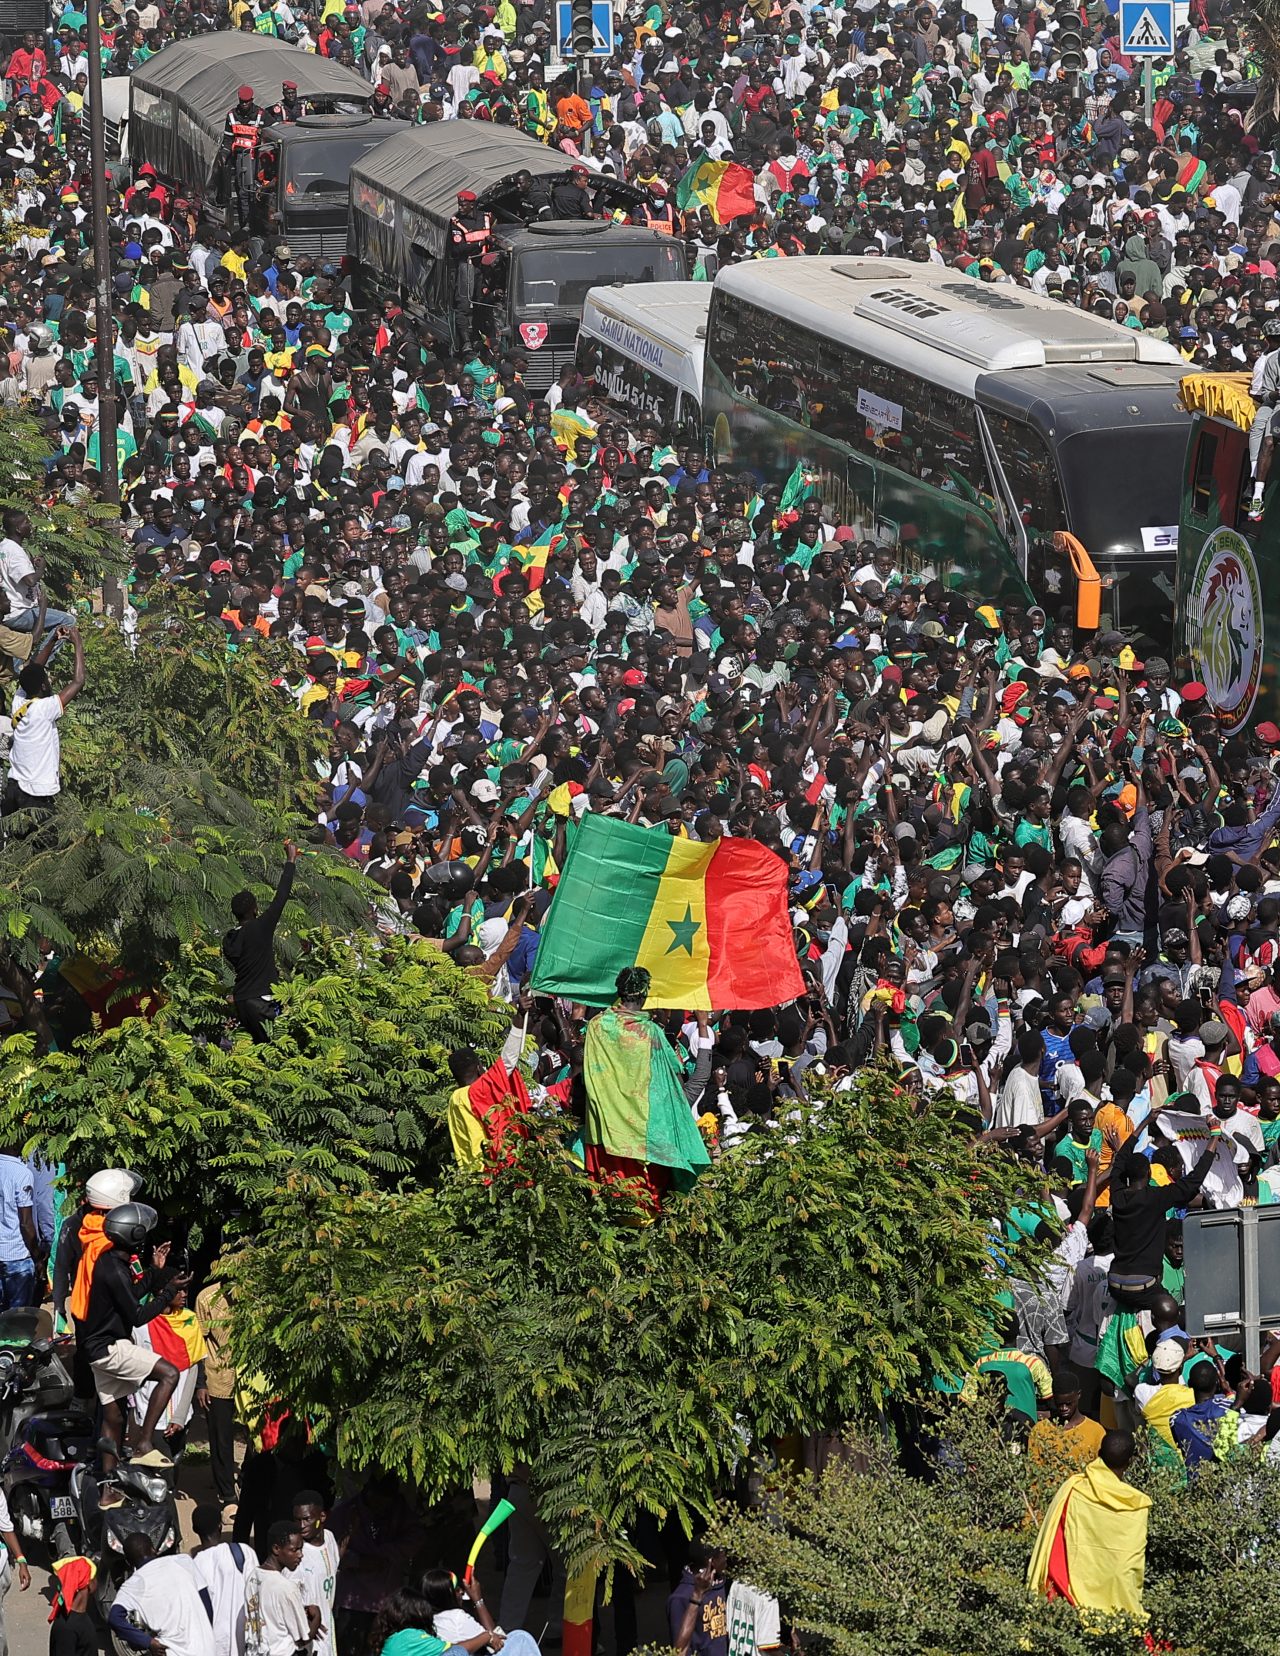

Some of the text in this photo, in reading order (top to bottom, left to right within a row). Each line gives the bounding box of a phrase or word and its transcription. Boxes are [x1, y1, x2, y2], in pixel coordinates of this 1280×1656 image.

[650, 223, 672, 231] POLICE
[600, 316, 664, 367] SAMU NATIONAL
[58, 1498, 72, 1508] AA
